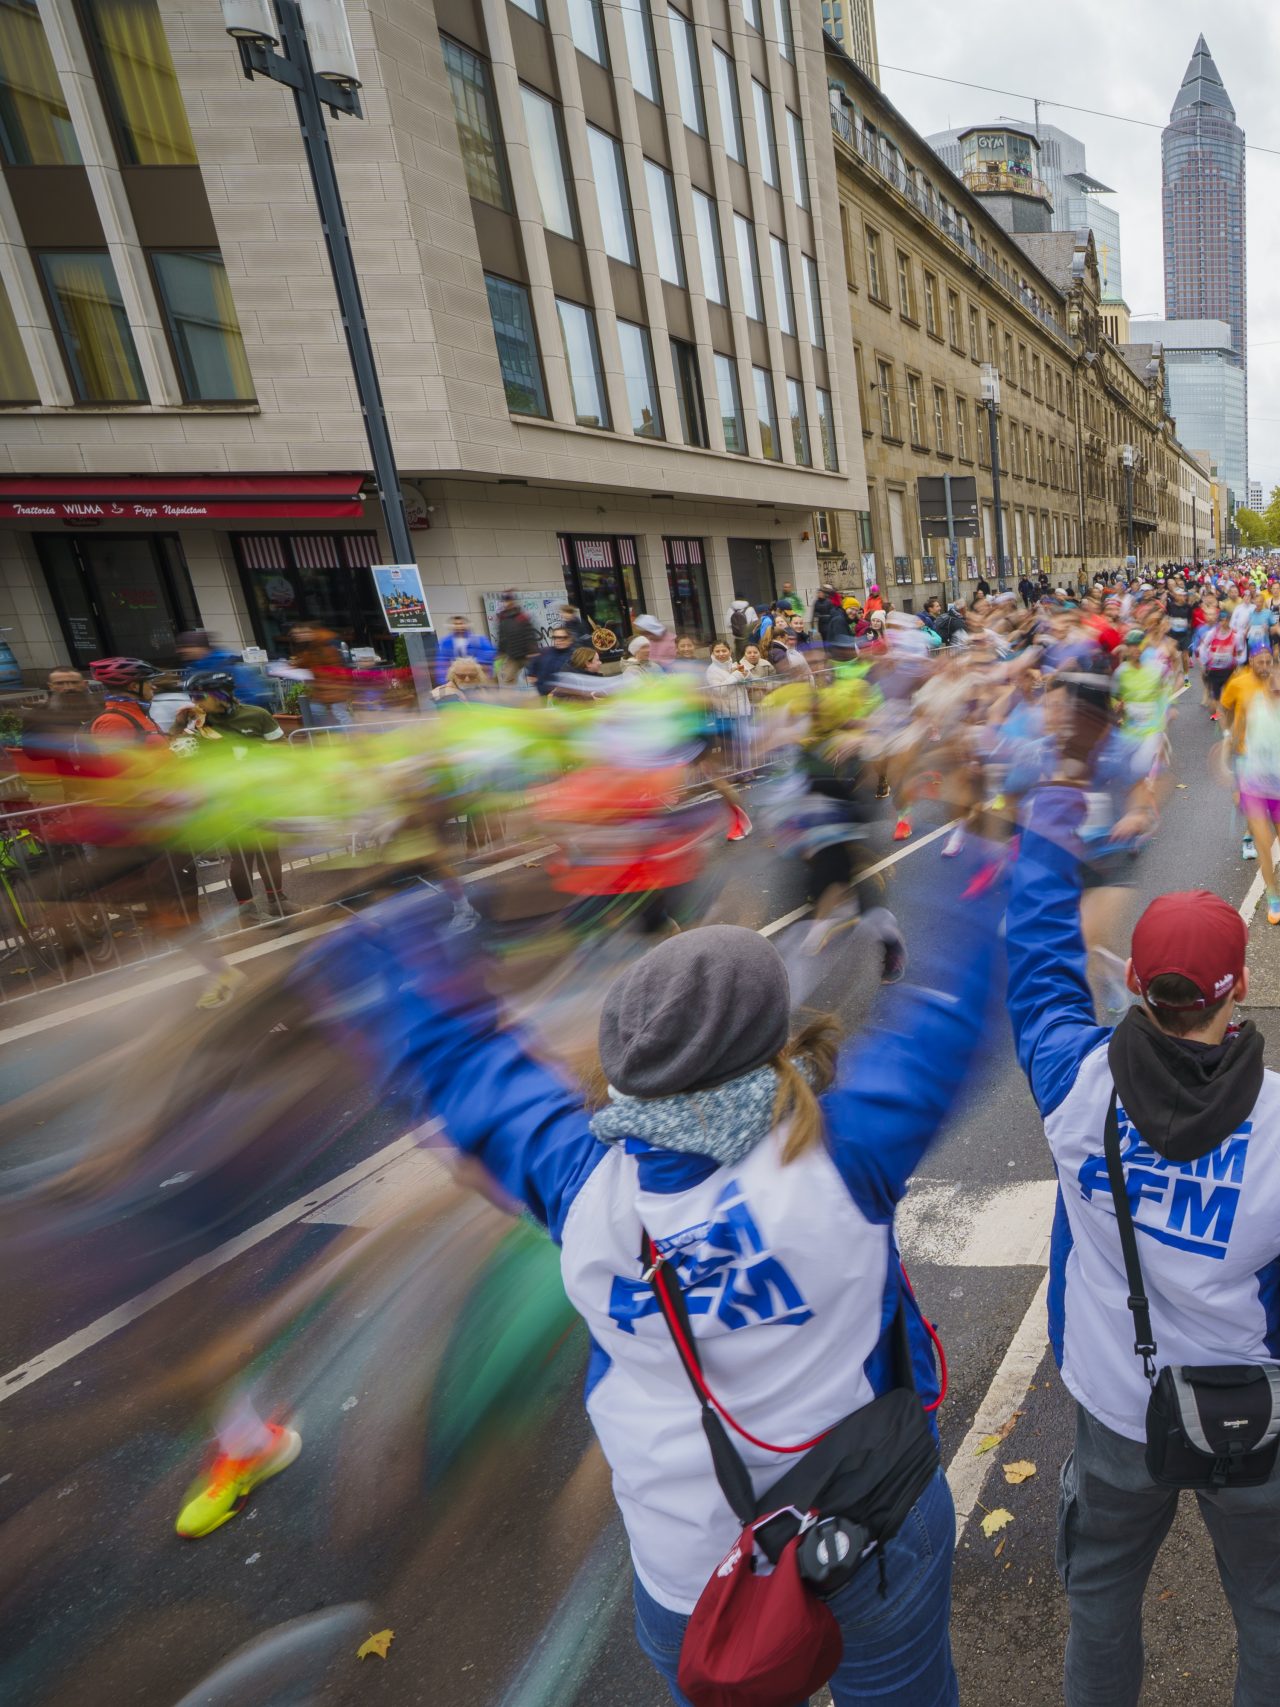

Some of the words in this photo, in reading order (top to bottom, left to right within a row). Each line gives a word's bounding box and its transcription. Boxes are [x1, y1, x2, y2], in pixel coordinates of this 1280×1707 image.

[978, 135, 1004, 149] GYM
[12, 504, 56, 515] Trattoria
[62, 504, 104, 515] WILMA
[133, 505, 158, 517] Pizza
[162, 504, 208, 516] Napoletana
